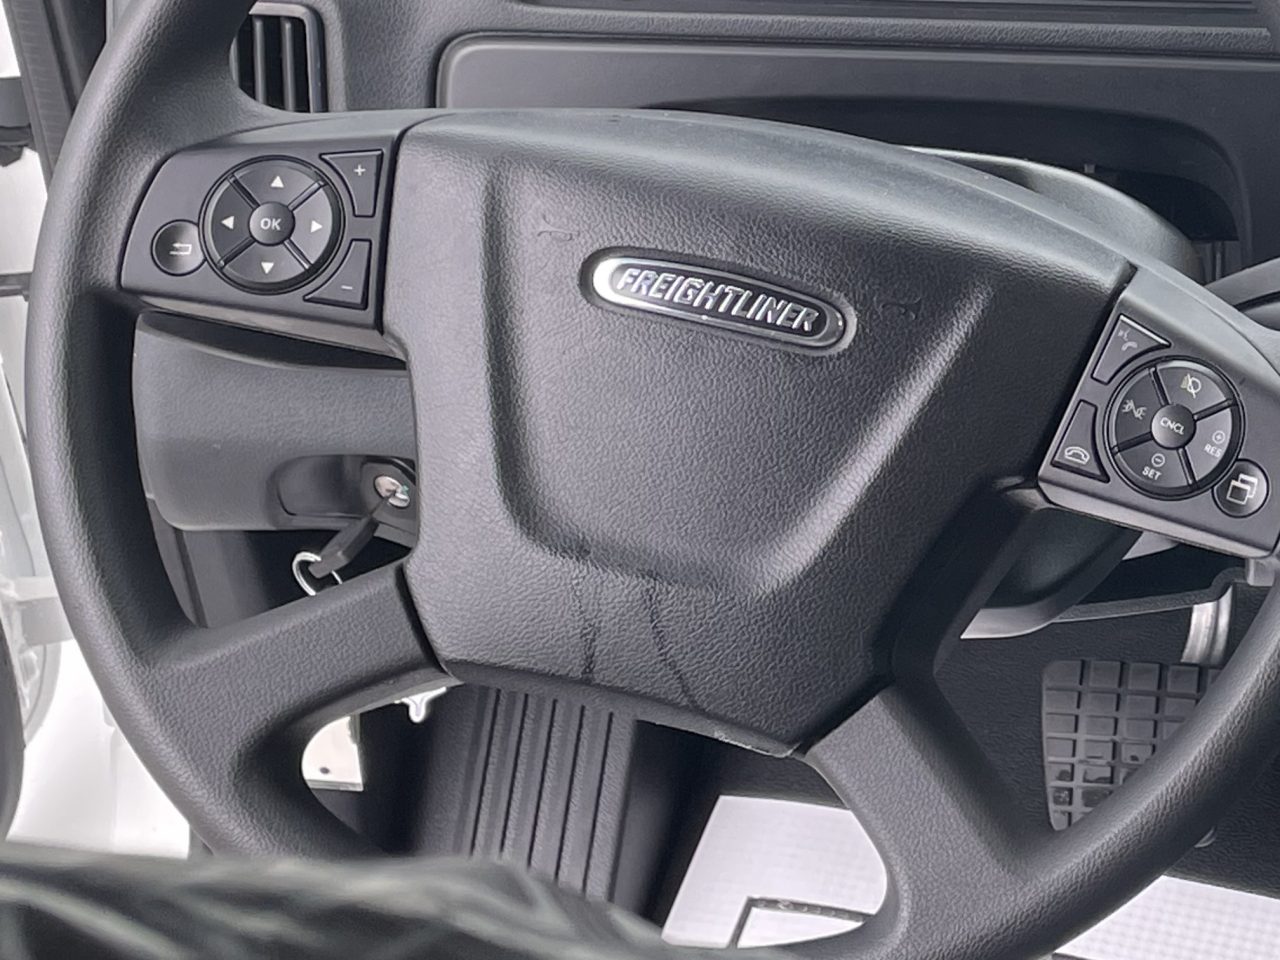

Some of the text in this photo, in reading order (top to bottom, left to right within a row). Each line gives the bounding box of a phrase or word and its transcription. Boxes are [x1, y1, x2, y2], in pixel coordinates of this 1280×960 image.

[260, 217, 282, 231] OK
[616, 267, 820, 332] FREIGHTLINER
[1159, 415, 1186, 436] CNCL
[1203, 443, 1223, 458] RES
[1142, 466, 1163, 481] SET
